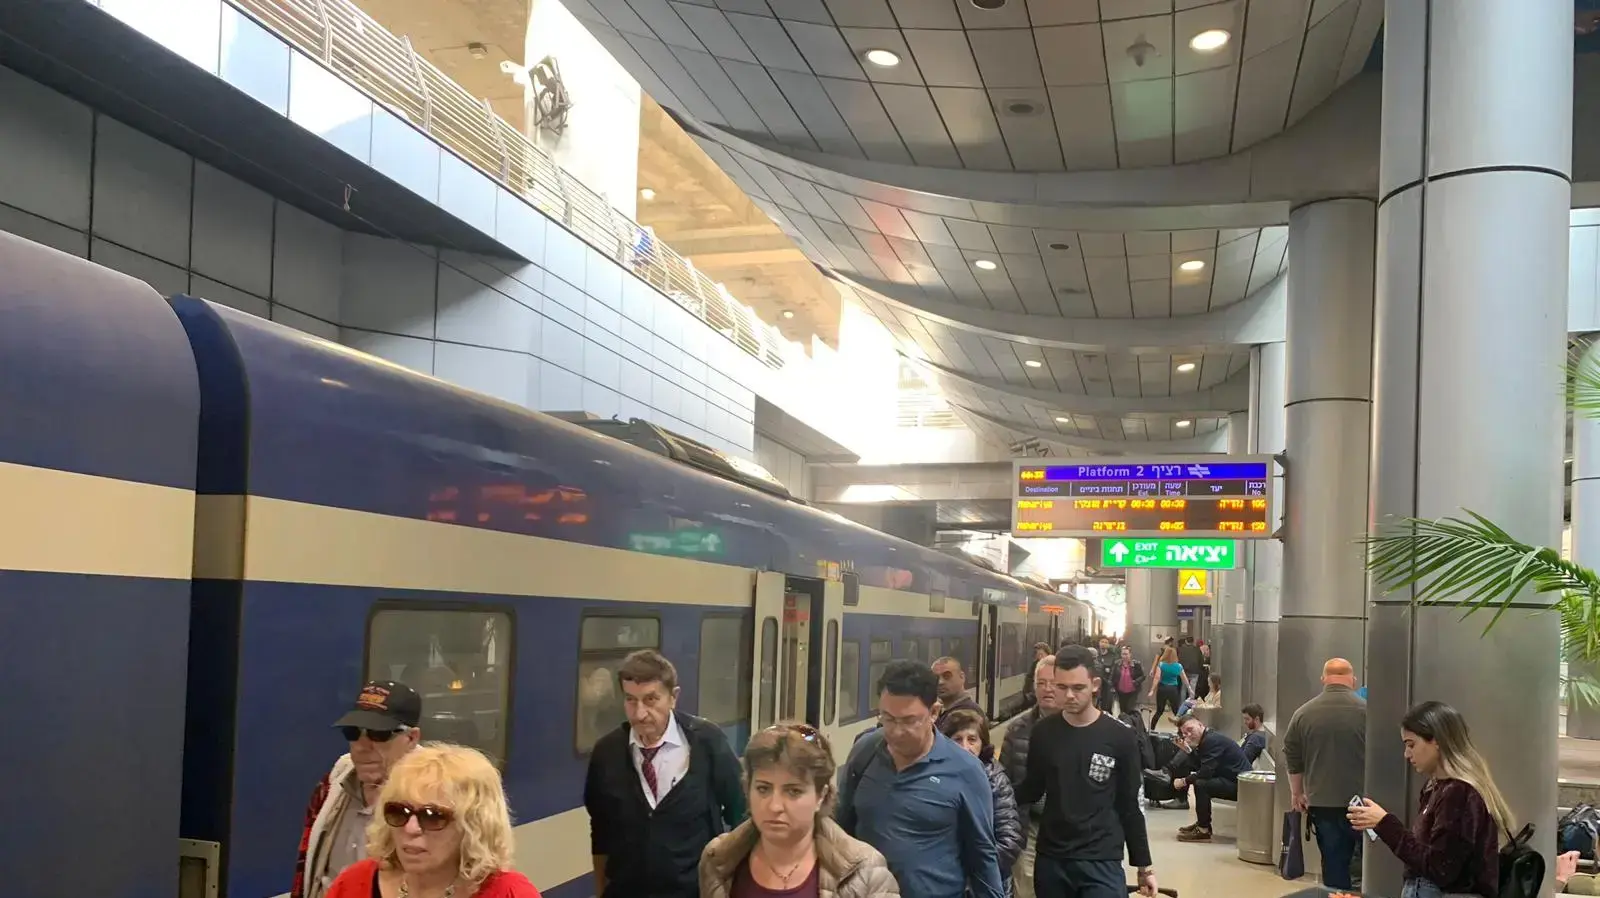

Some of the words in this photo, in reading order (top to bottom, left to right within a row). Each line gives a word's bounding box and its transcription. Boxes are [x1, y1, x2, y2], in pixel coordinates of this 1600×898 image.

[1078, 466, 1130, 477] Platform
[1136, 465, 1144, 477] 2
[1151, 465, 1182, 479] רציף
[1165, 489, 1181, 497] Time
[1135, 542, 1158, 551] EXIT
[1165, 544, 1228, 563] יציאה
